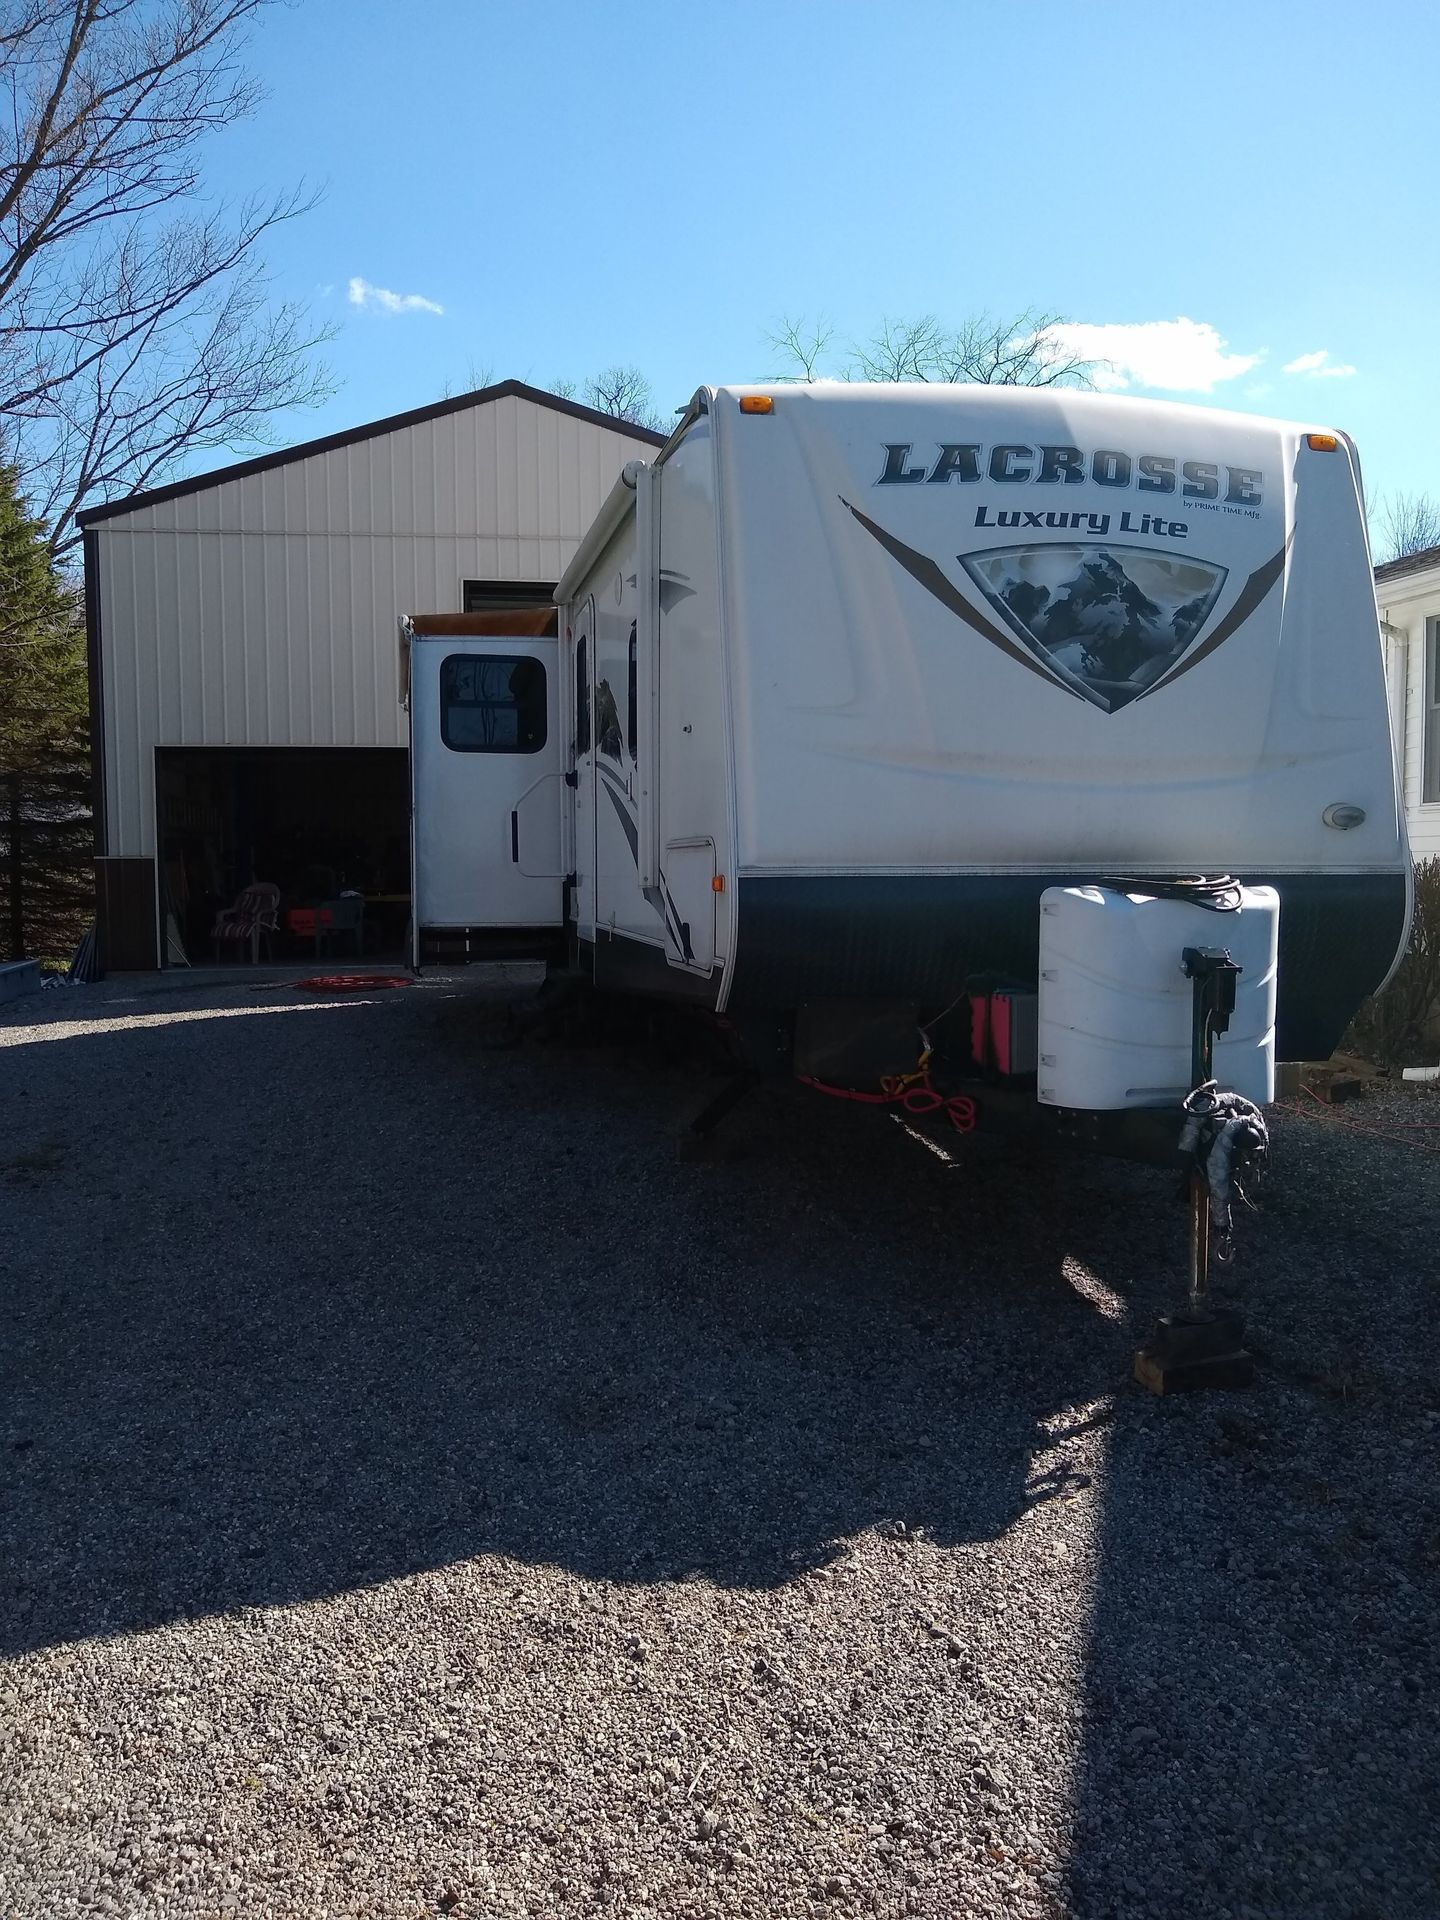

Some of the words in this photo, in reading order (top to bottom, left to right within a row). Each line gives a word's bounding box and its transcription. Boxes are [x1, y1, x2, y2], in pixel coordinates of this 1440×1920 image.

[874, 442, 1263, 506] LACROSSE
[974, 506, 1110, 535] Luxury
[1119, 511, 1188, 538] Lite
[1183, 500, 1193, 508] by
[1194, 502, 1220, 511] PRIME
[1222, 506, 1242, 515] TIME
